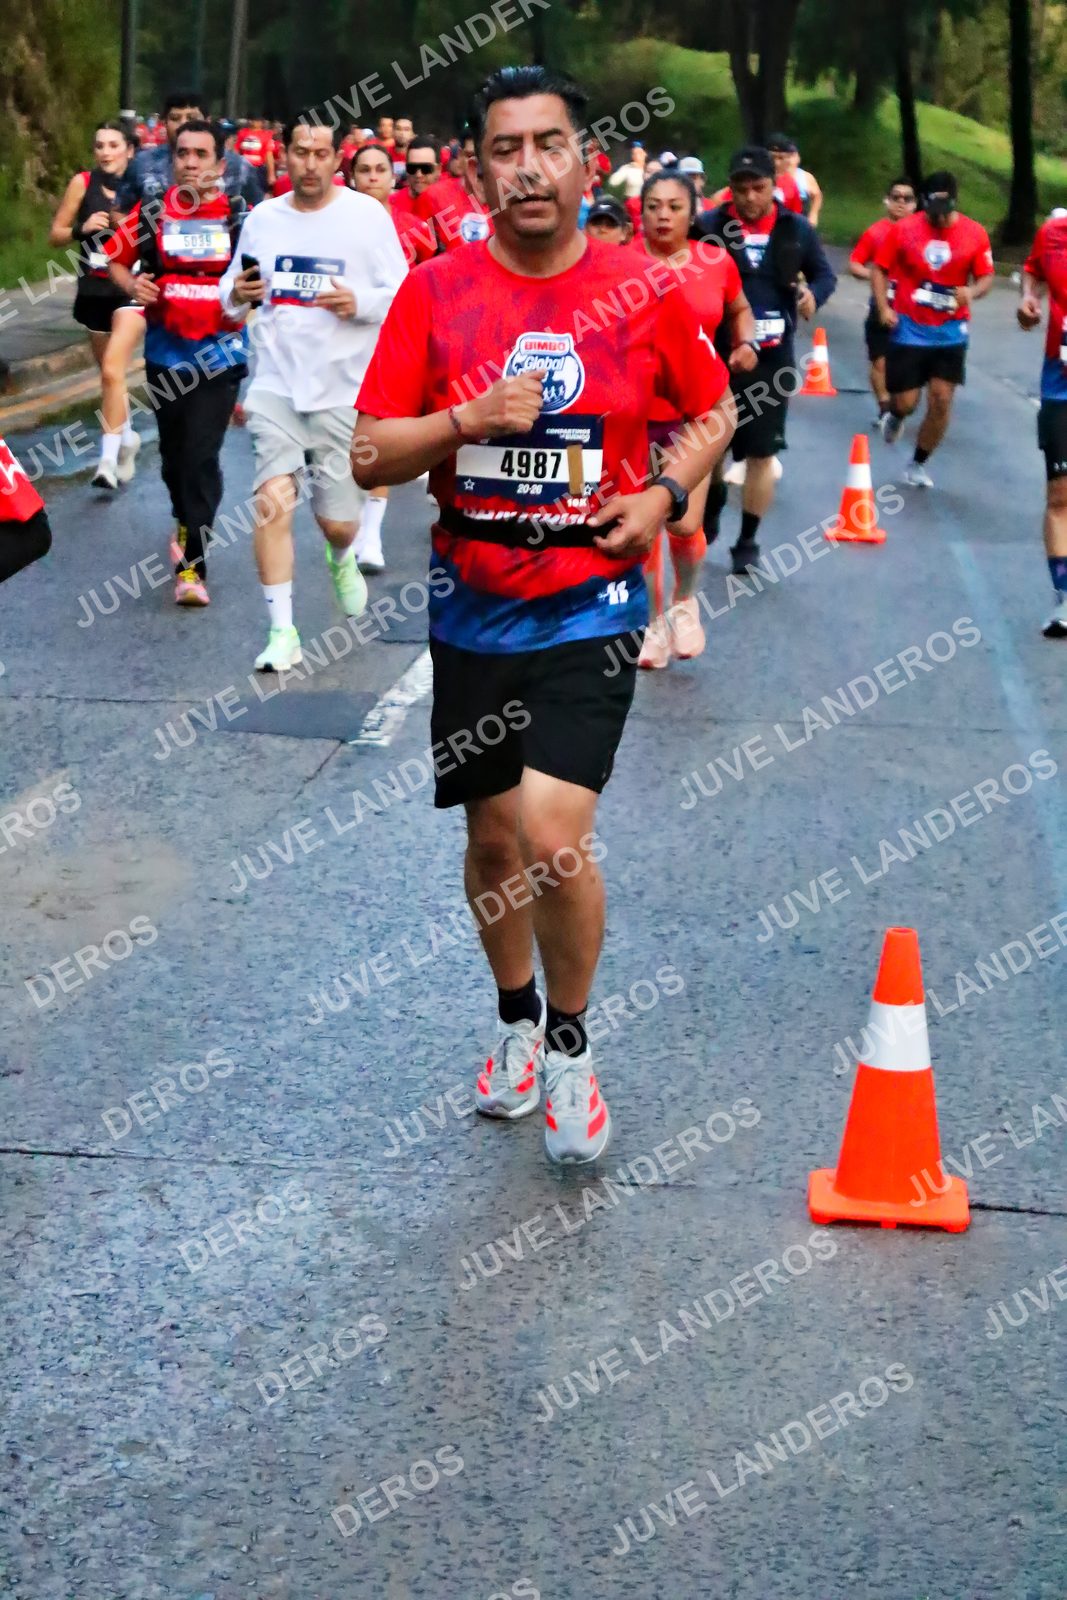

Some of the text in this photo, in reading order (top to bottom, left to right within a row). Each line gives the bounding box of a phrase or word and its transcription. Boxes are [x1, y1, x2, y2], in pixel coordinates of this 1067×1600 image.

[294, 274, 323, 290] 4627
[525, 341, 566, 351] BIMBO
[525, 356, 565, 371] Global
[501, 450, 562, 479] 4987
[567, 498, 588, 508] 10K
